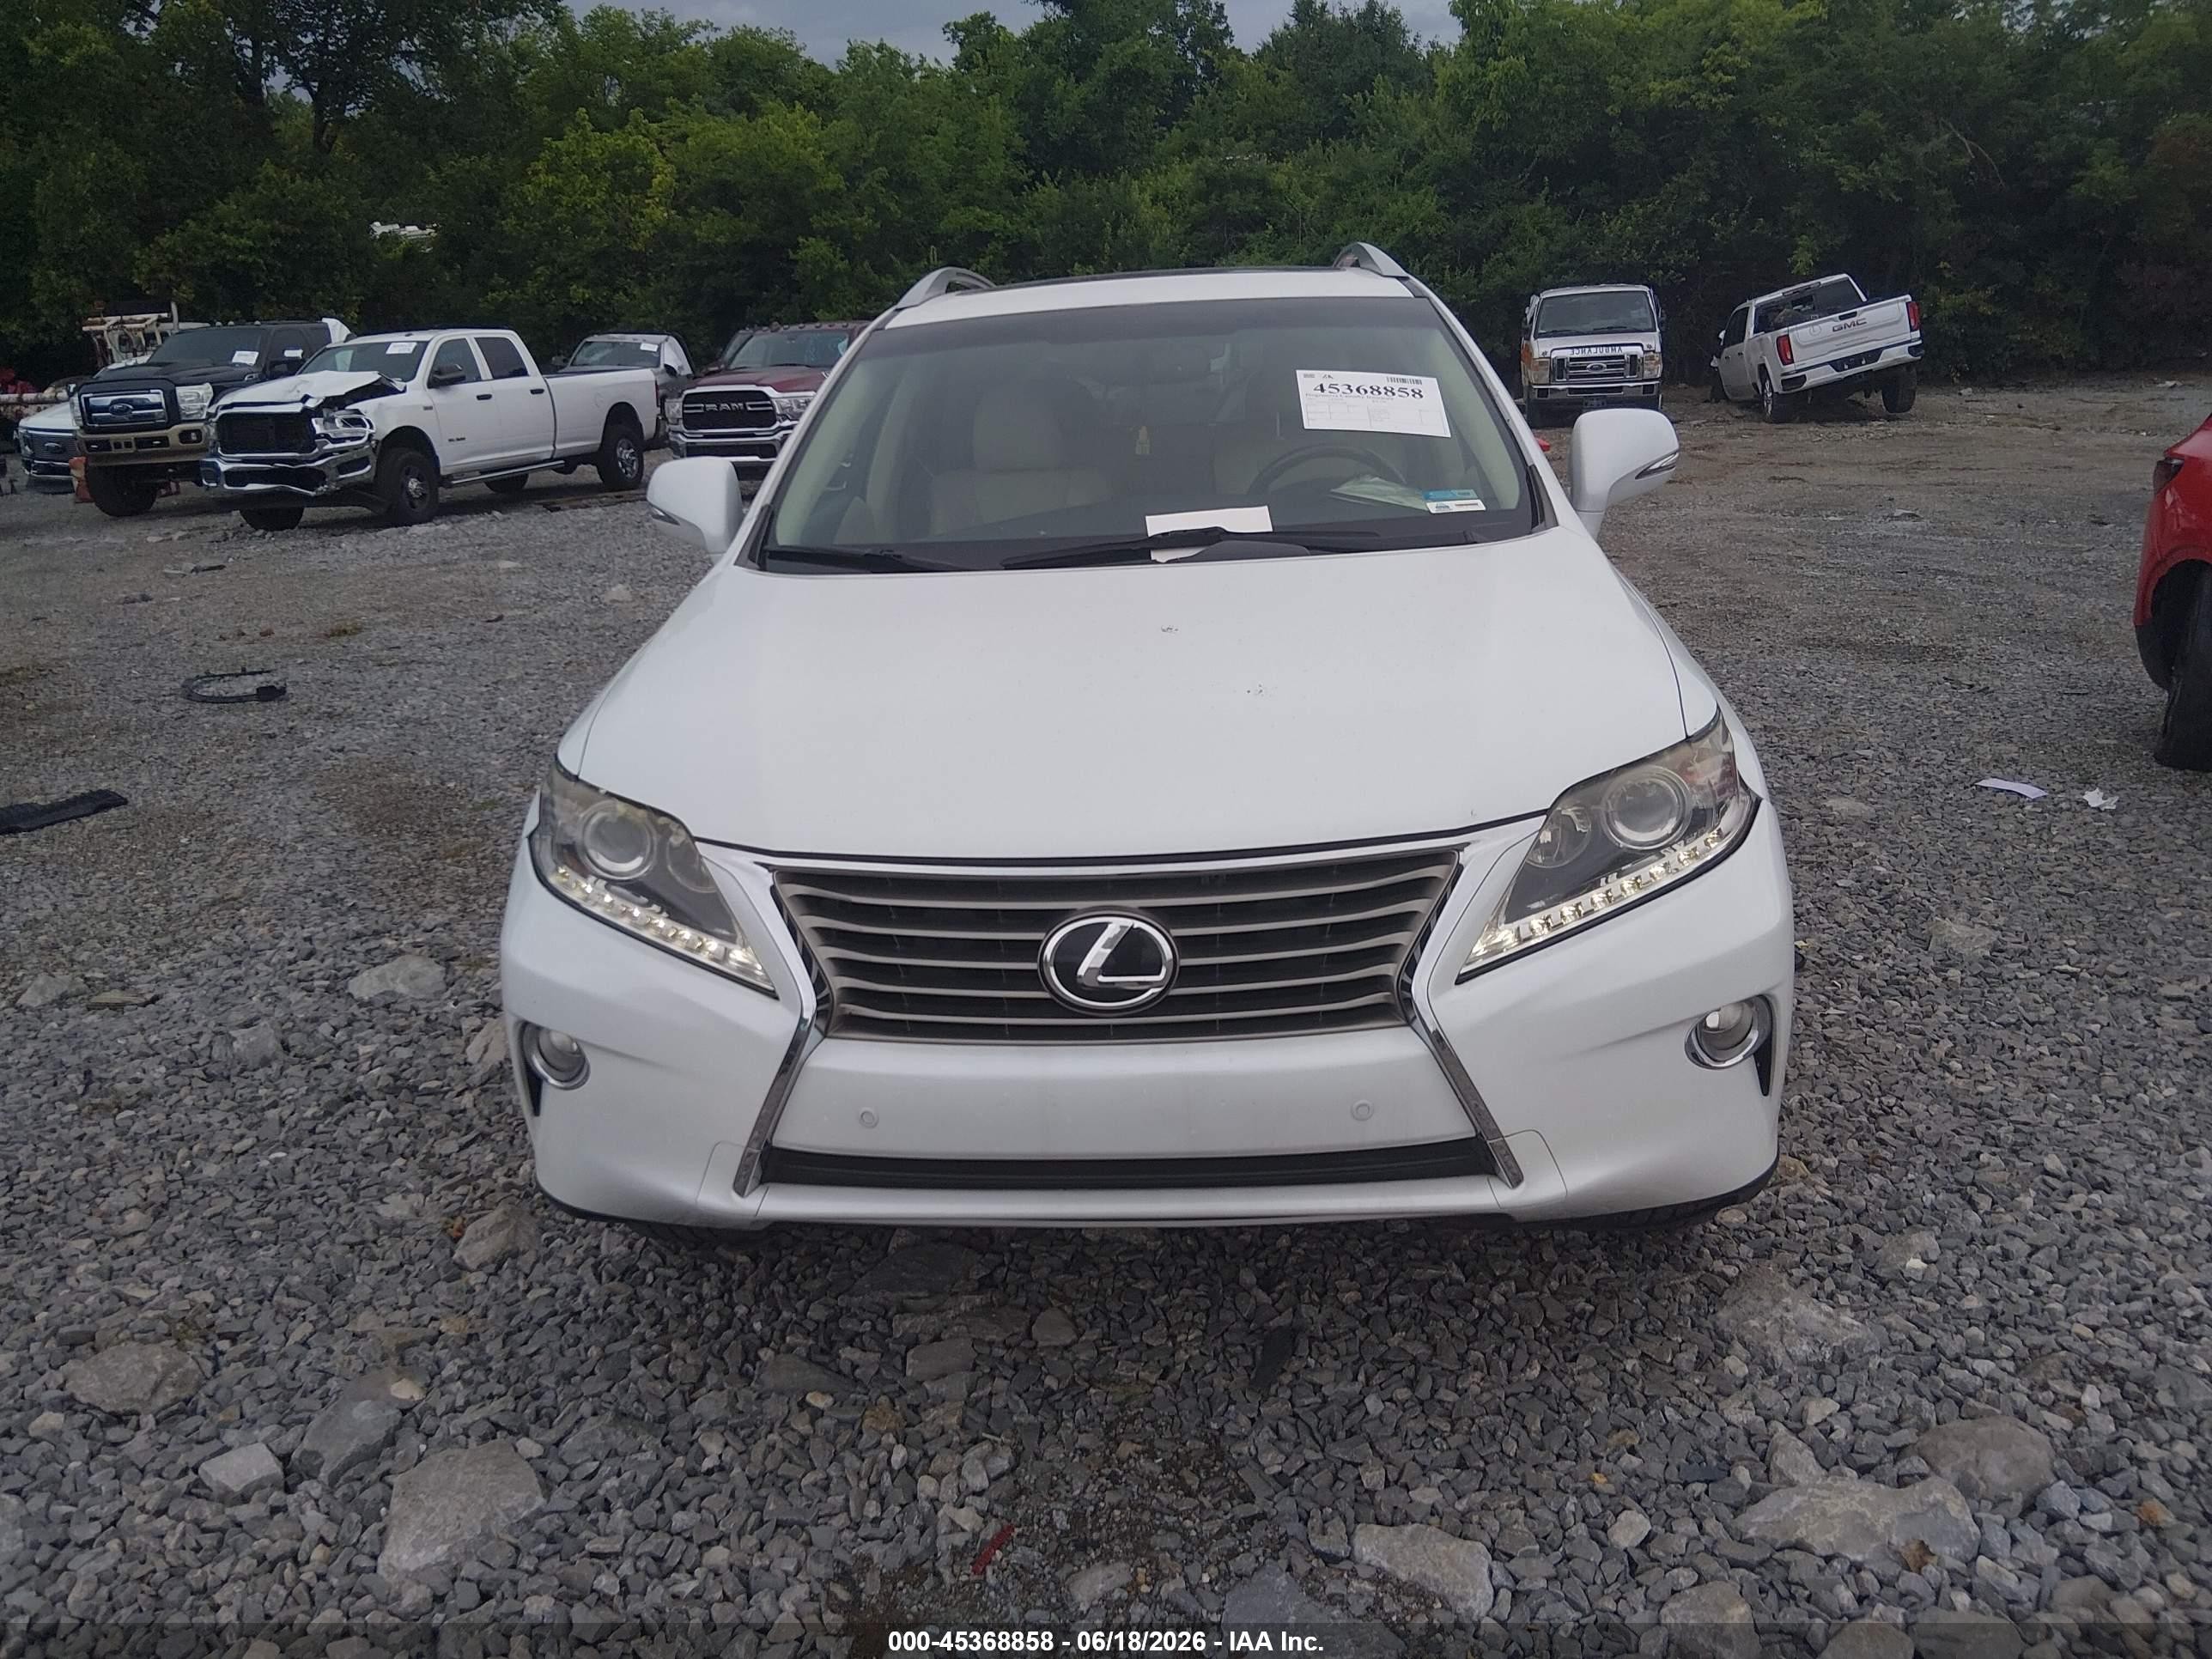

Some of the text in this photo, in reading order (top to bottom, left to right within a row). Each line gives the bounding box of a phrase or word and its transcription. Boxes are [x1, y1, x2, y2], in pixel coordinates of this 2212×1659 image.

[1832, 318, 1867, 332] GMC
[1313, 383, 1424, 399] 45368858
[704, 402, 744, 411] RAM
